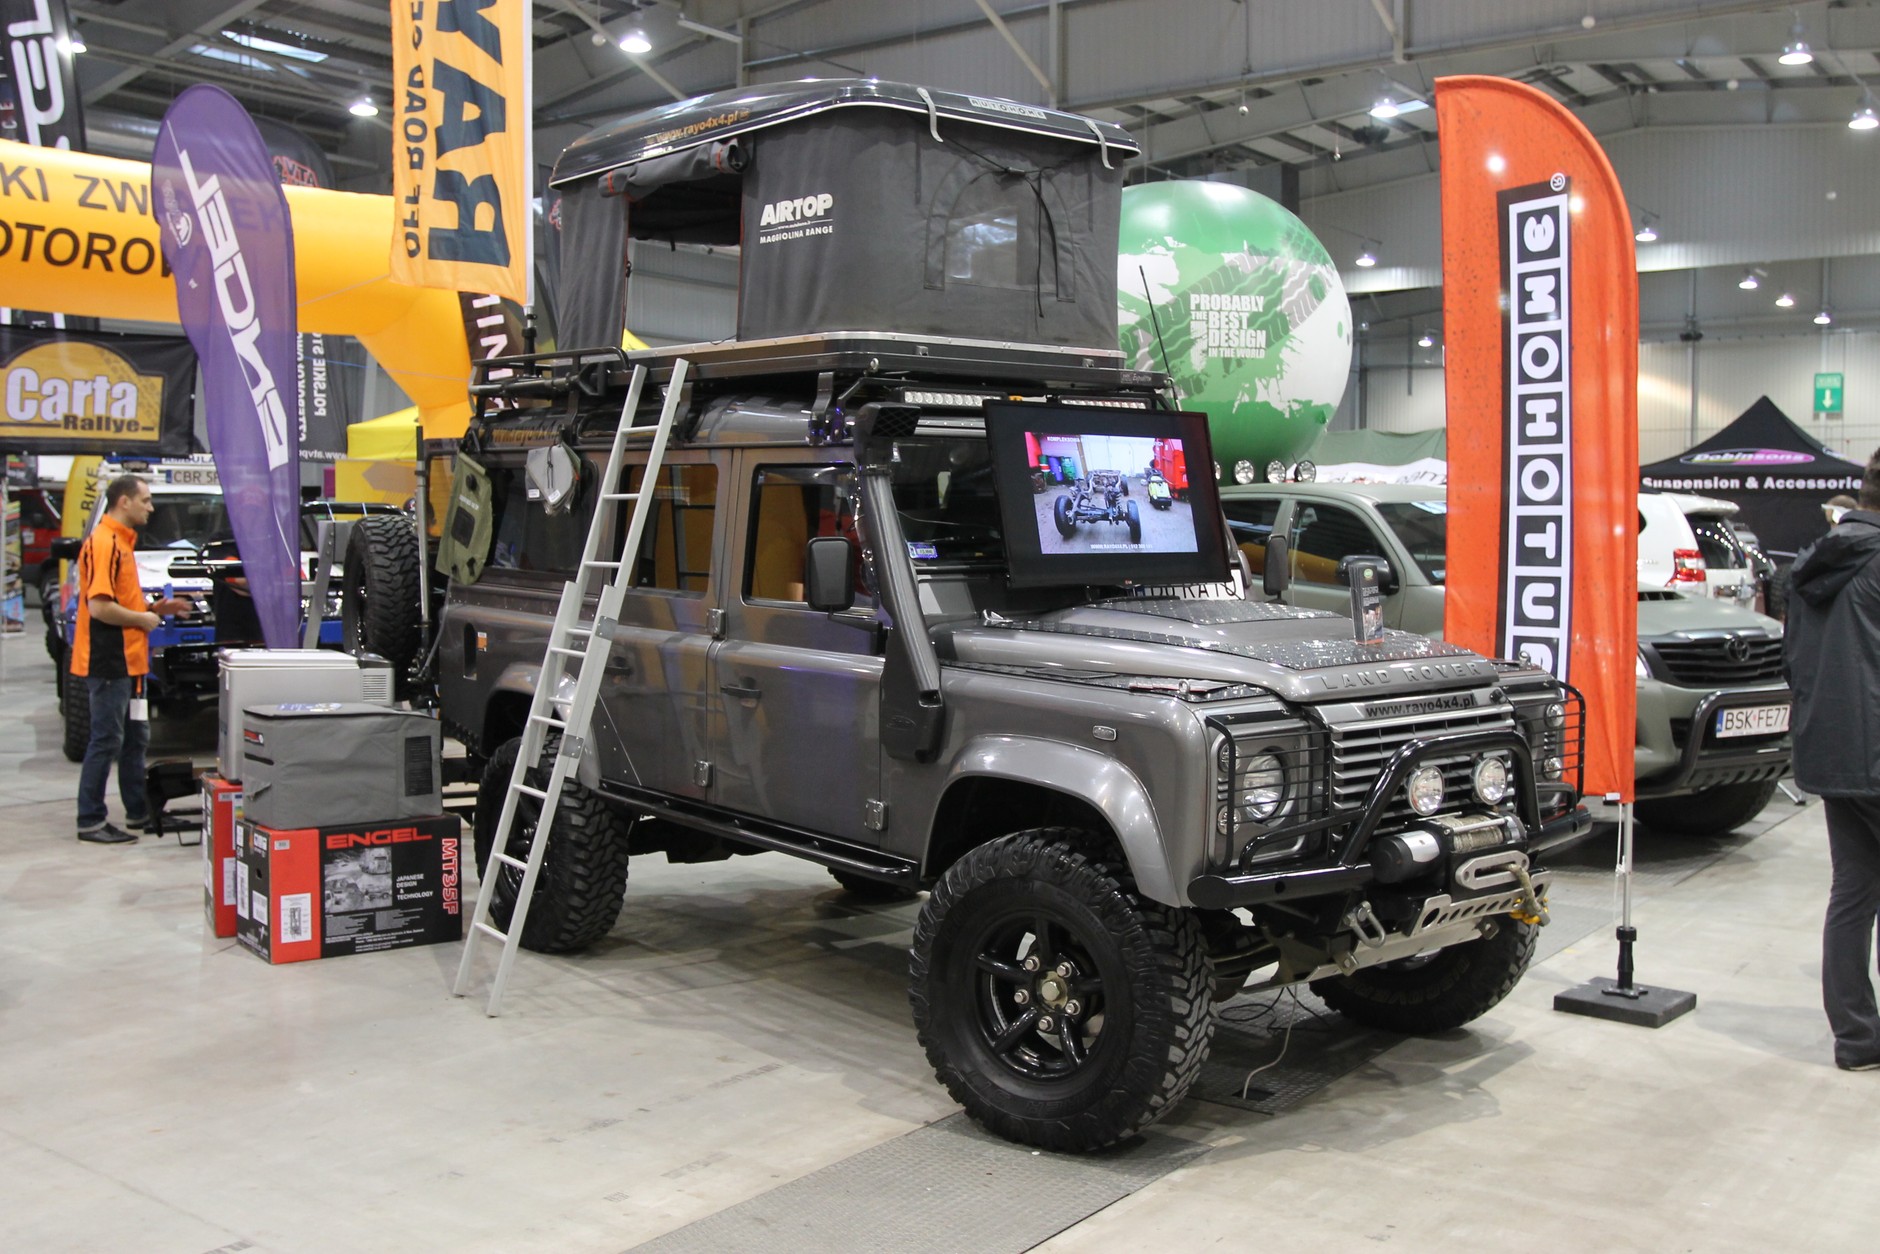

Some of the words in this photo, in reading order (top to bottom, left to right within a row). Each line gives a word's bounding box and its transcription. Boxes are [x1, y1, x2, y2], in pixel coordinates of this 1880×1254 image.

[656, 110, 738, 142] www.rayo4x4.pl
[760, 193, 833, 226] AIRTOP
[760, 230, 804, 244] MAGGIOLINA
[805, 225, 833, 237] RANGE
[1190, 293, 1264, 312] PROBABLY
[1190, 311, 1208, 320] THE
[1208, 311, 1250, 330] BEST
[1208, 328, 1266, 348] DESIGN
[1208, 347, 1218, 358] IN
[1219, 347, 1236, 358] THE
[1236, 348, 1265, 359] WORLD
[6, 367, 138, 422] Carta
[63, 414, 140, 433] Rallye
[173, 470, 201, 483] CBR
[1642, 475, 1740, 491] Suspension
[1745, 476, 1759, 490] &
[1321, 669, 1391, 690] LAND
[1403, 662, 1482, 682] ROVER
[1365, 692, 1475, 718] www.rayo4x4.pl
[1724, 709, 1754, 731] BSK
[1756, 706, 1788, 728] FE77
[326, 827, 433, 850] ENGEL
[396, 873, 425, 882] JAPANESE
[396, 880, 417, 889] DESIGN
[441, 837, 459, 916] MT35F
[396, 890, 434, 901] TECHNOLOGY
